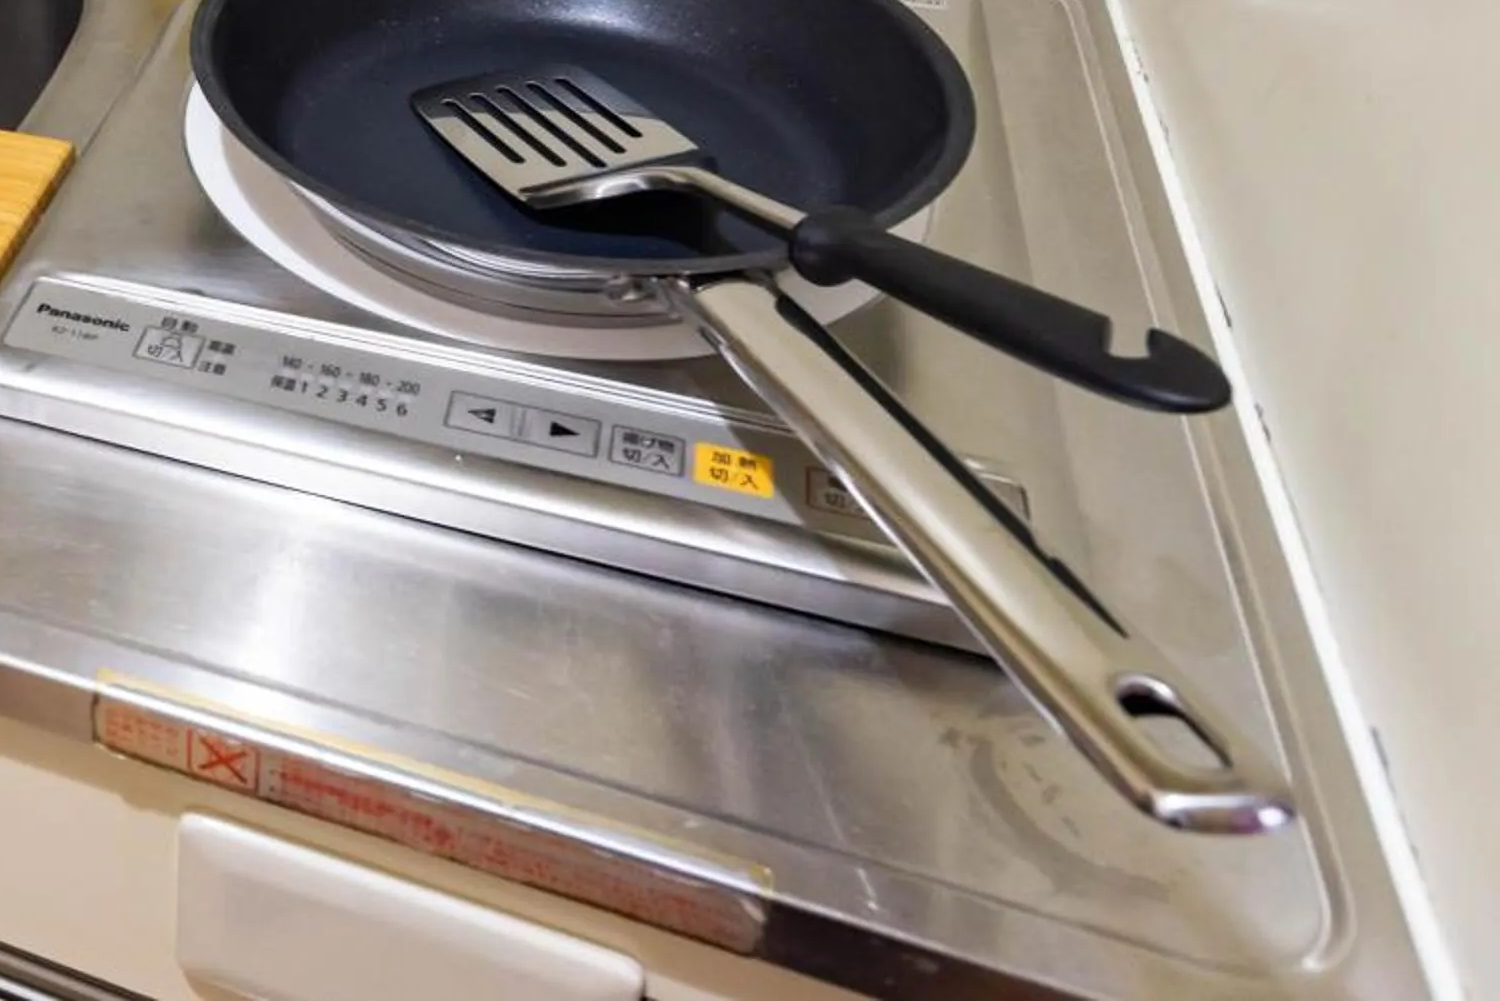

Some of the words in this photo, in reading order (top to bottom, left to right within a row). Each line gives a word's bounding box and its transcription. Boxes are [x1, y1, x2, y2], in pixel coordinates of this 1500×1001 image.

[36, 303, 130, 332] Panasonic
[320, 363, 342, 378] 160
[396, 380, 421, 396] 200
[316, 385, 329, 399] 2
[336, 389, 349, 402] 3
[355, 394, 368, 407] 4
[375, 398, 388, 412] 5
[396, 402, 408, 417] 6
